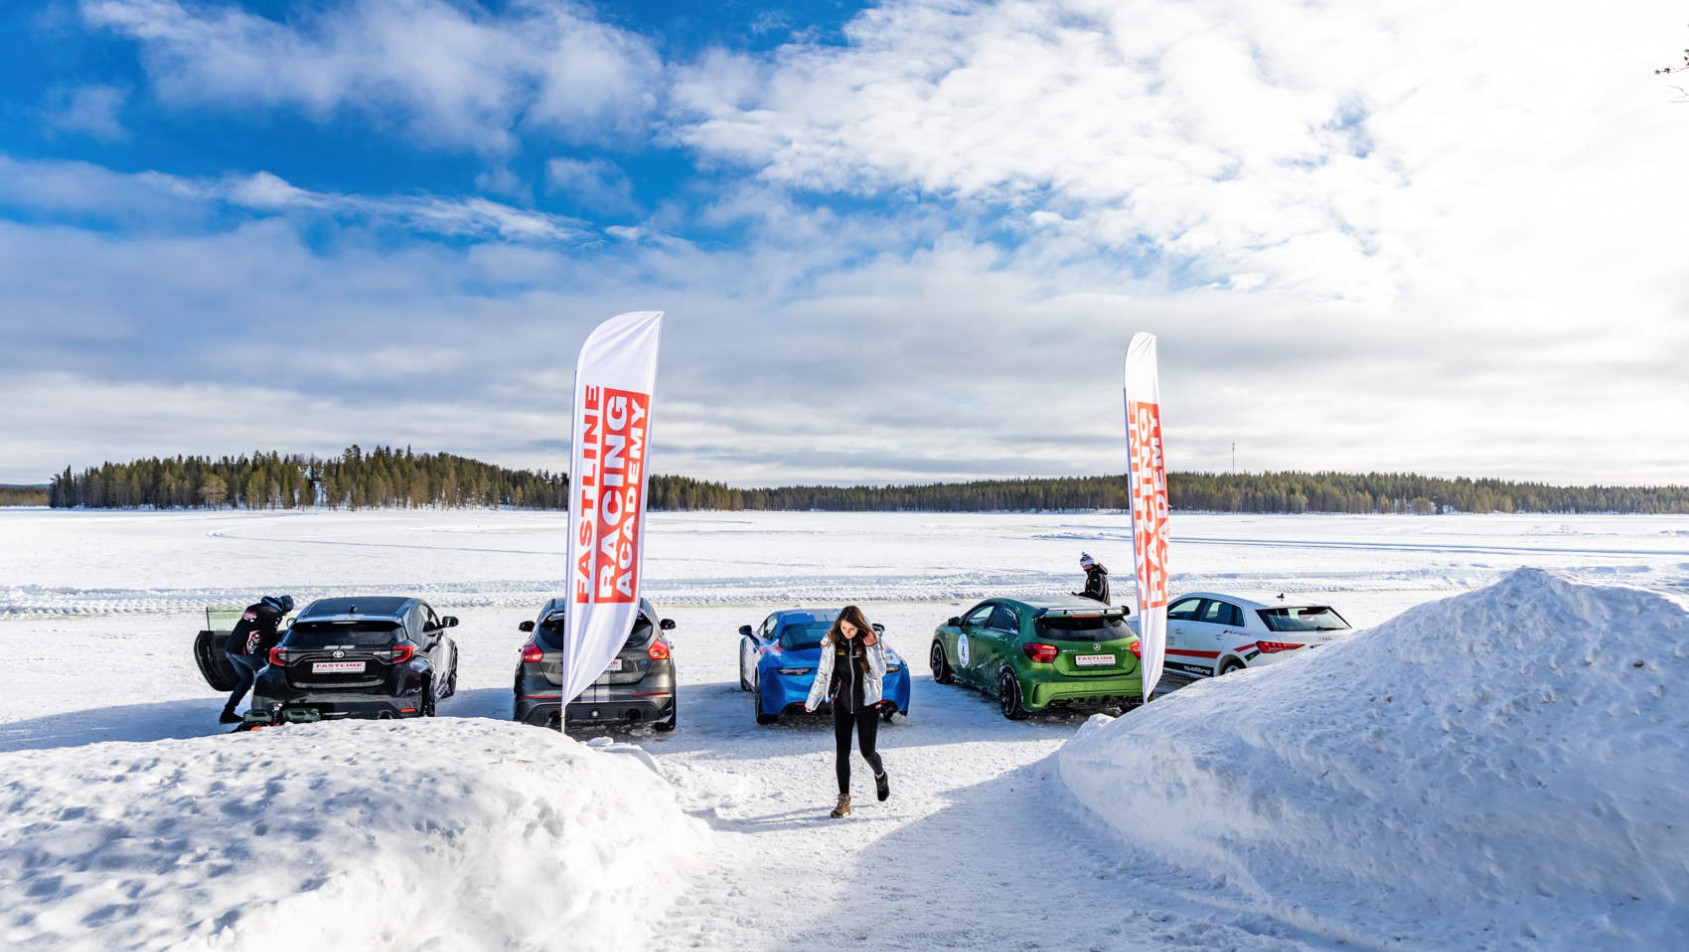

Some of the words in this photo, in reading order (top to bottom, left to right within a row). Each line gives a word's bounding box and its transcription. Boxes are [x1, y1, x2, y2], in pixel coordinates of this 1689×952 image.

[577, 384, 600, 603] FASTLINE
[599, 396, 628, 598] RACING
[616, 398, 646, 598] ACADEMY
[1128, 400, 1148, 610] FASTLINE
[1139, 409, 1163, 602] RACING
